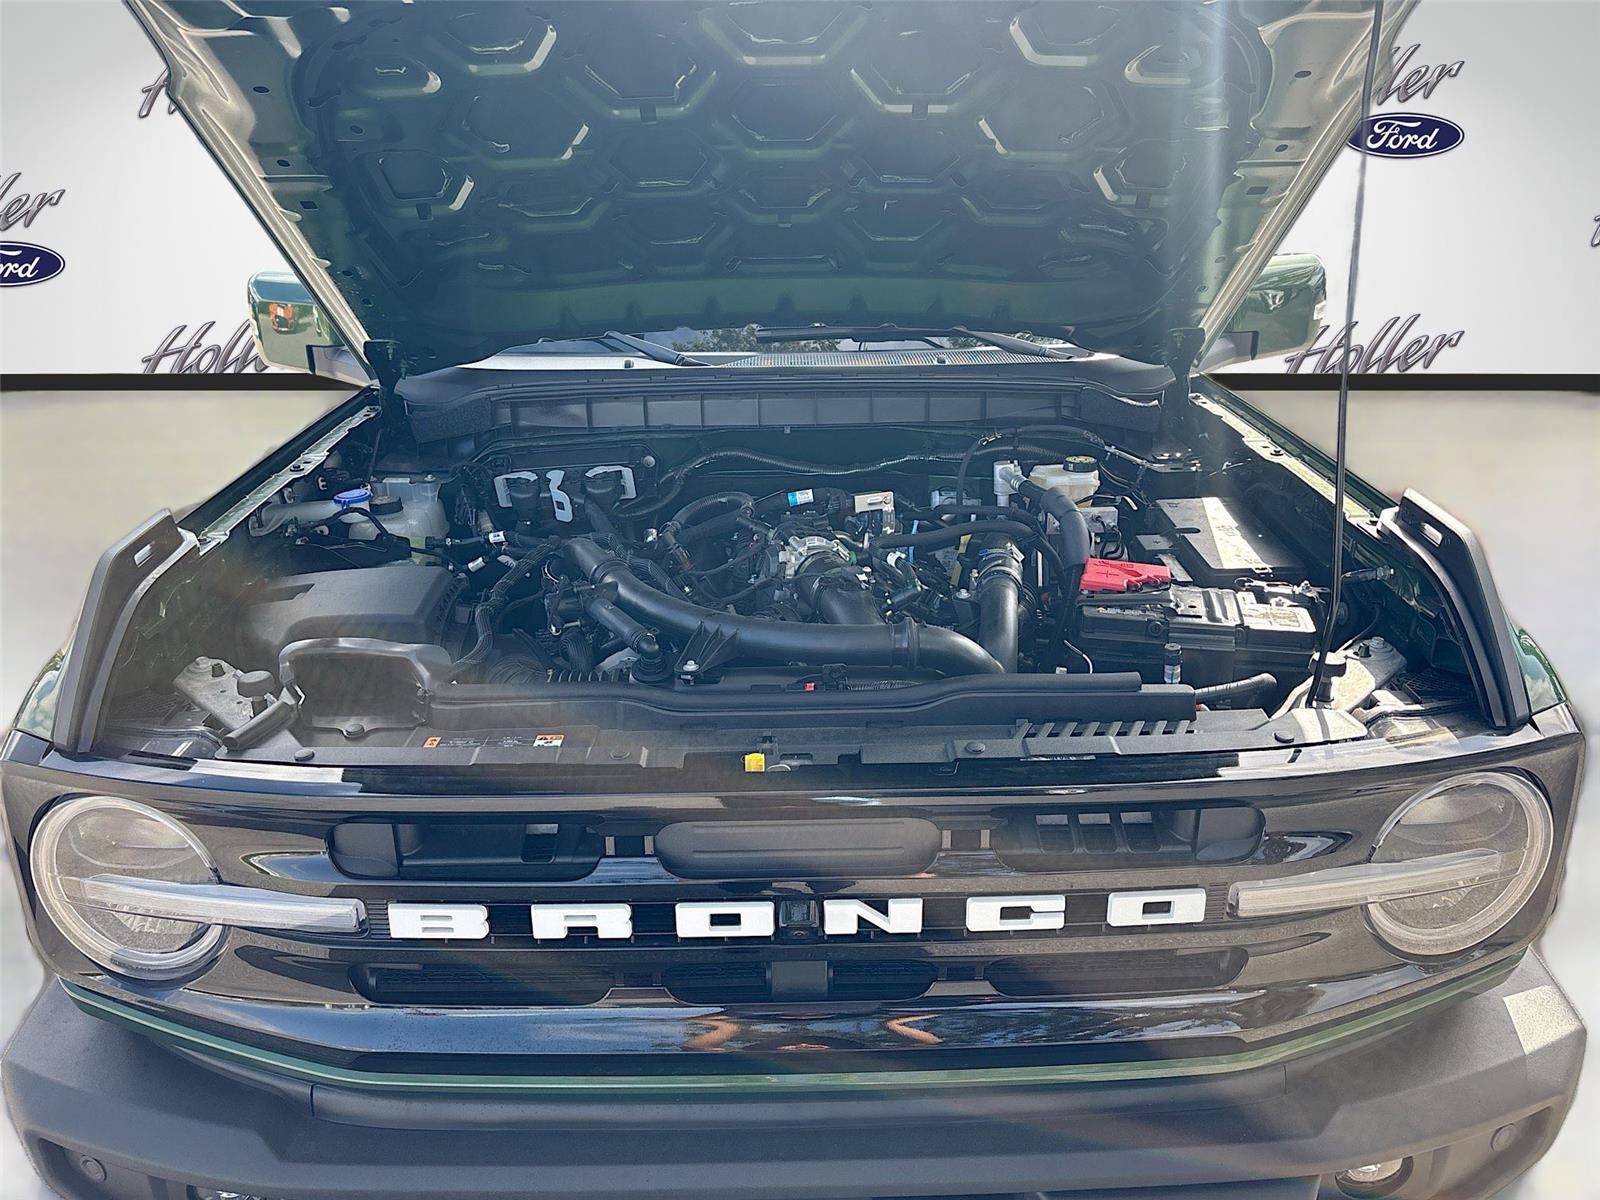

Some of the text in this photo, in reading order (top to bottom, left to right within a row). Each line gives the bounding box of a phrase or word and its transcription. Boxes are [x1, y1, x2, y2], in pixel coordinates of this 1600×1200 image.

[1376, 43, 1465, 106] ler
[1366, 119, 1440, 149] Ford
[0, 172, 66, 231] ler
[0, 249, 41, 278] rd
[141, 318, 270, 374] Holl
[1285, 313, 1465, 374] Holler
[388, 889, 1207, 939] BRONCO
